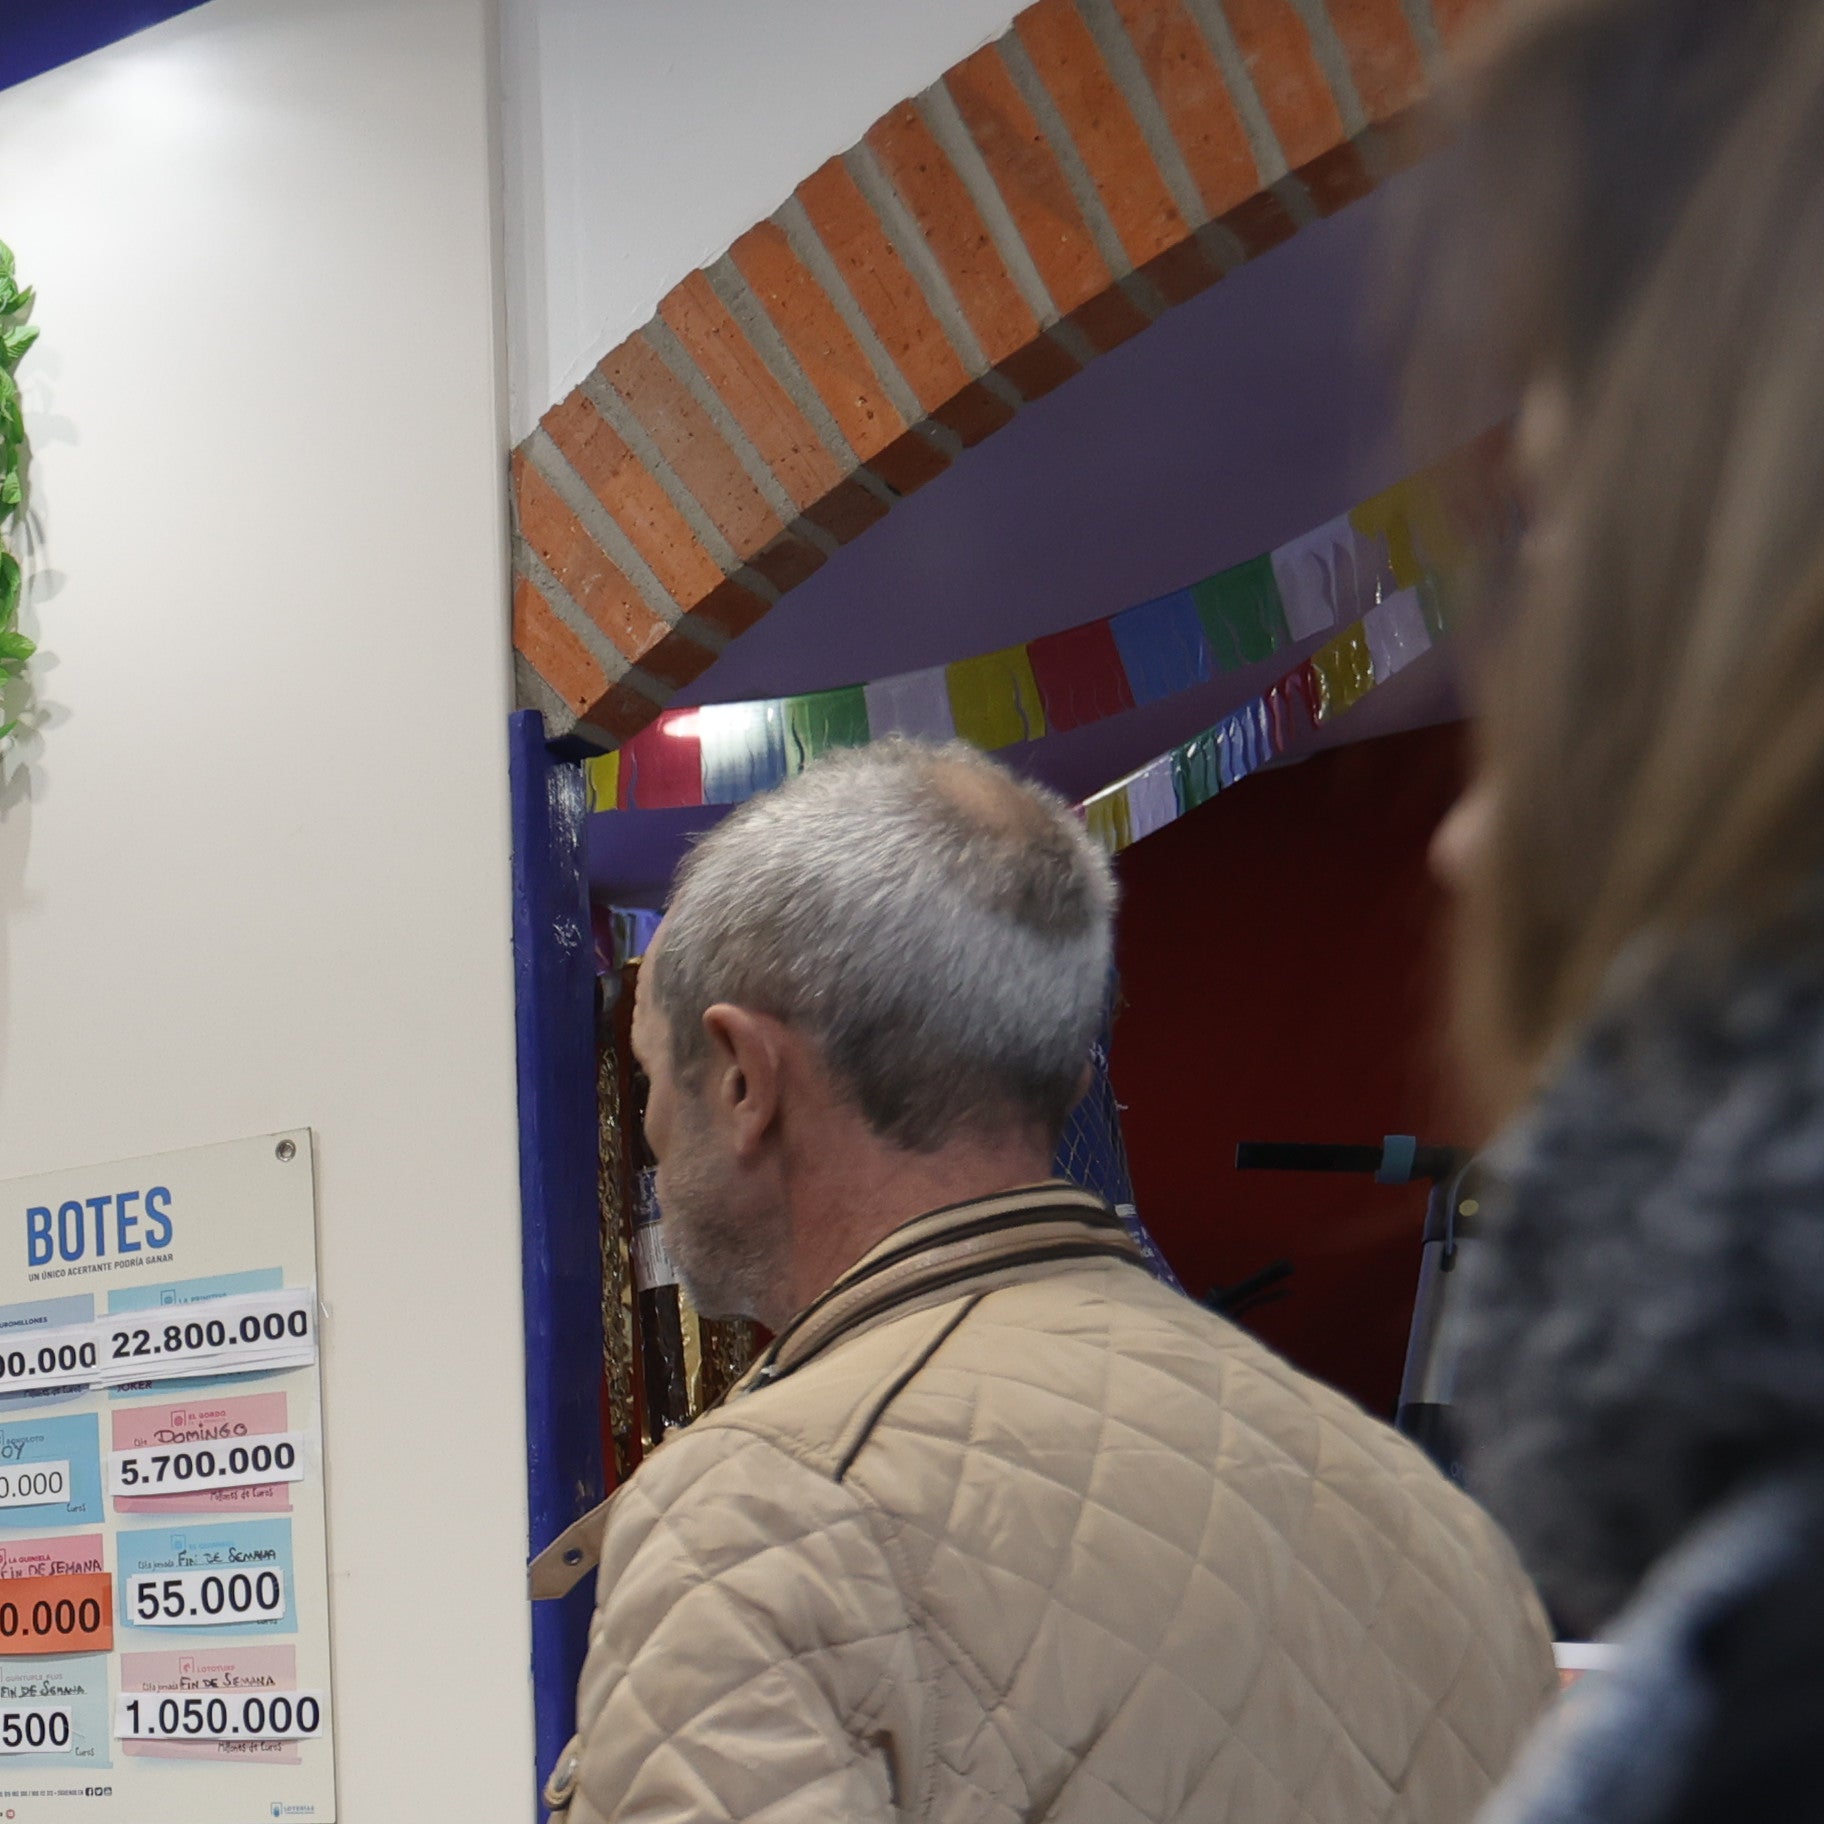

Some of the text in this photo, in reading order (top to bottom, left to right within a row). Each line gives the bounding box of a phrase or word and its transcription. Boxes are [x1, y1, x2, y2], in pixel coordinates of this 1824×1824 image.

[26, 1186, 173, 1268] BOTES
[28, 1253, 174, 1283] UN ÚNICO ACERTANTE PODRÍA GANAR
[111, 1309, 308, 1359] 22.800.000
[121, 1442, 296, 1486] 5.700.000
[137, 1571, 280, 1620] 55.000
[222, 1673, 276, 1688] SEMANA
[125, 1696, 320, 1735] 1.050.000
